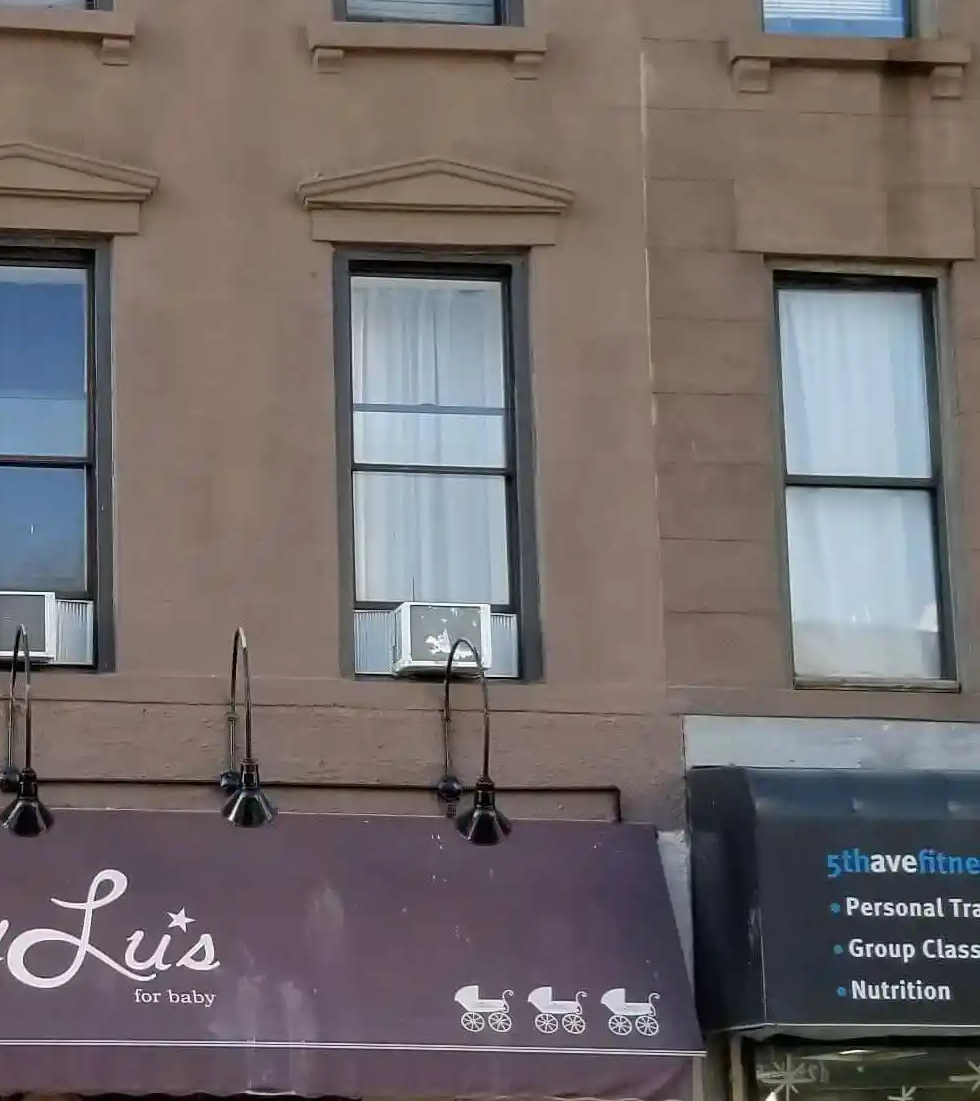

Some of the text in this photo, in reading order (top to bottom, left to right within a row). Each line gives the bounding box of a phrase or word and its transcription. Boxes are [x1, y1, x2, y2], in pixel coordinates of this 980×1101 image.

[846, 897, 944, 917] Personal
[848, 938, 980, 963] Group Class
[133, 988, 216, 1008] for baby
[851, 980, 951, 1000] Nutrition
